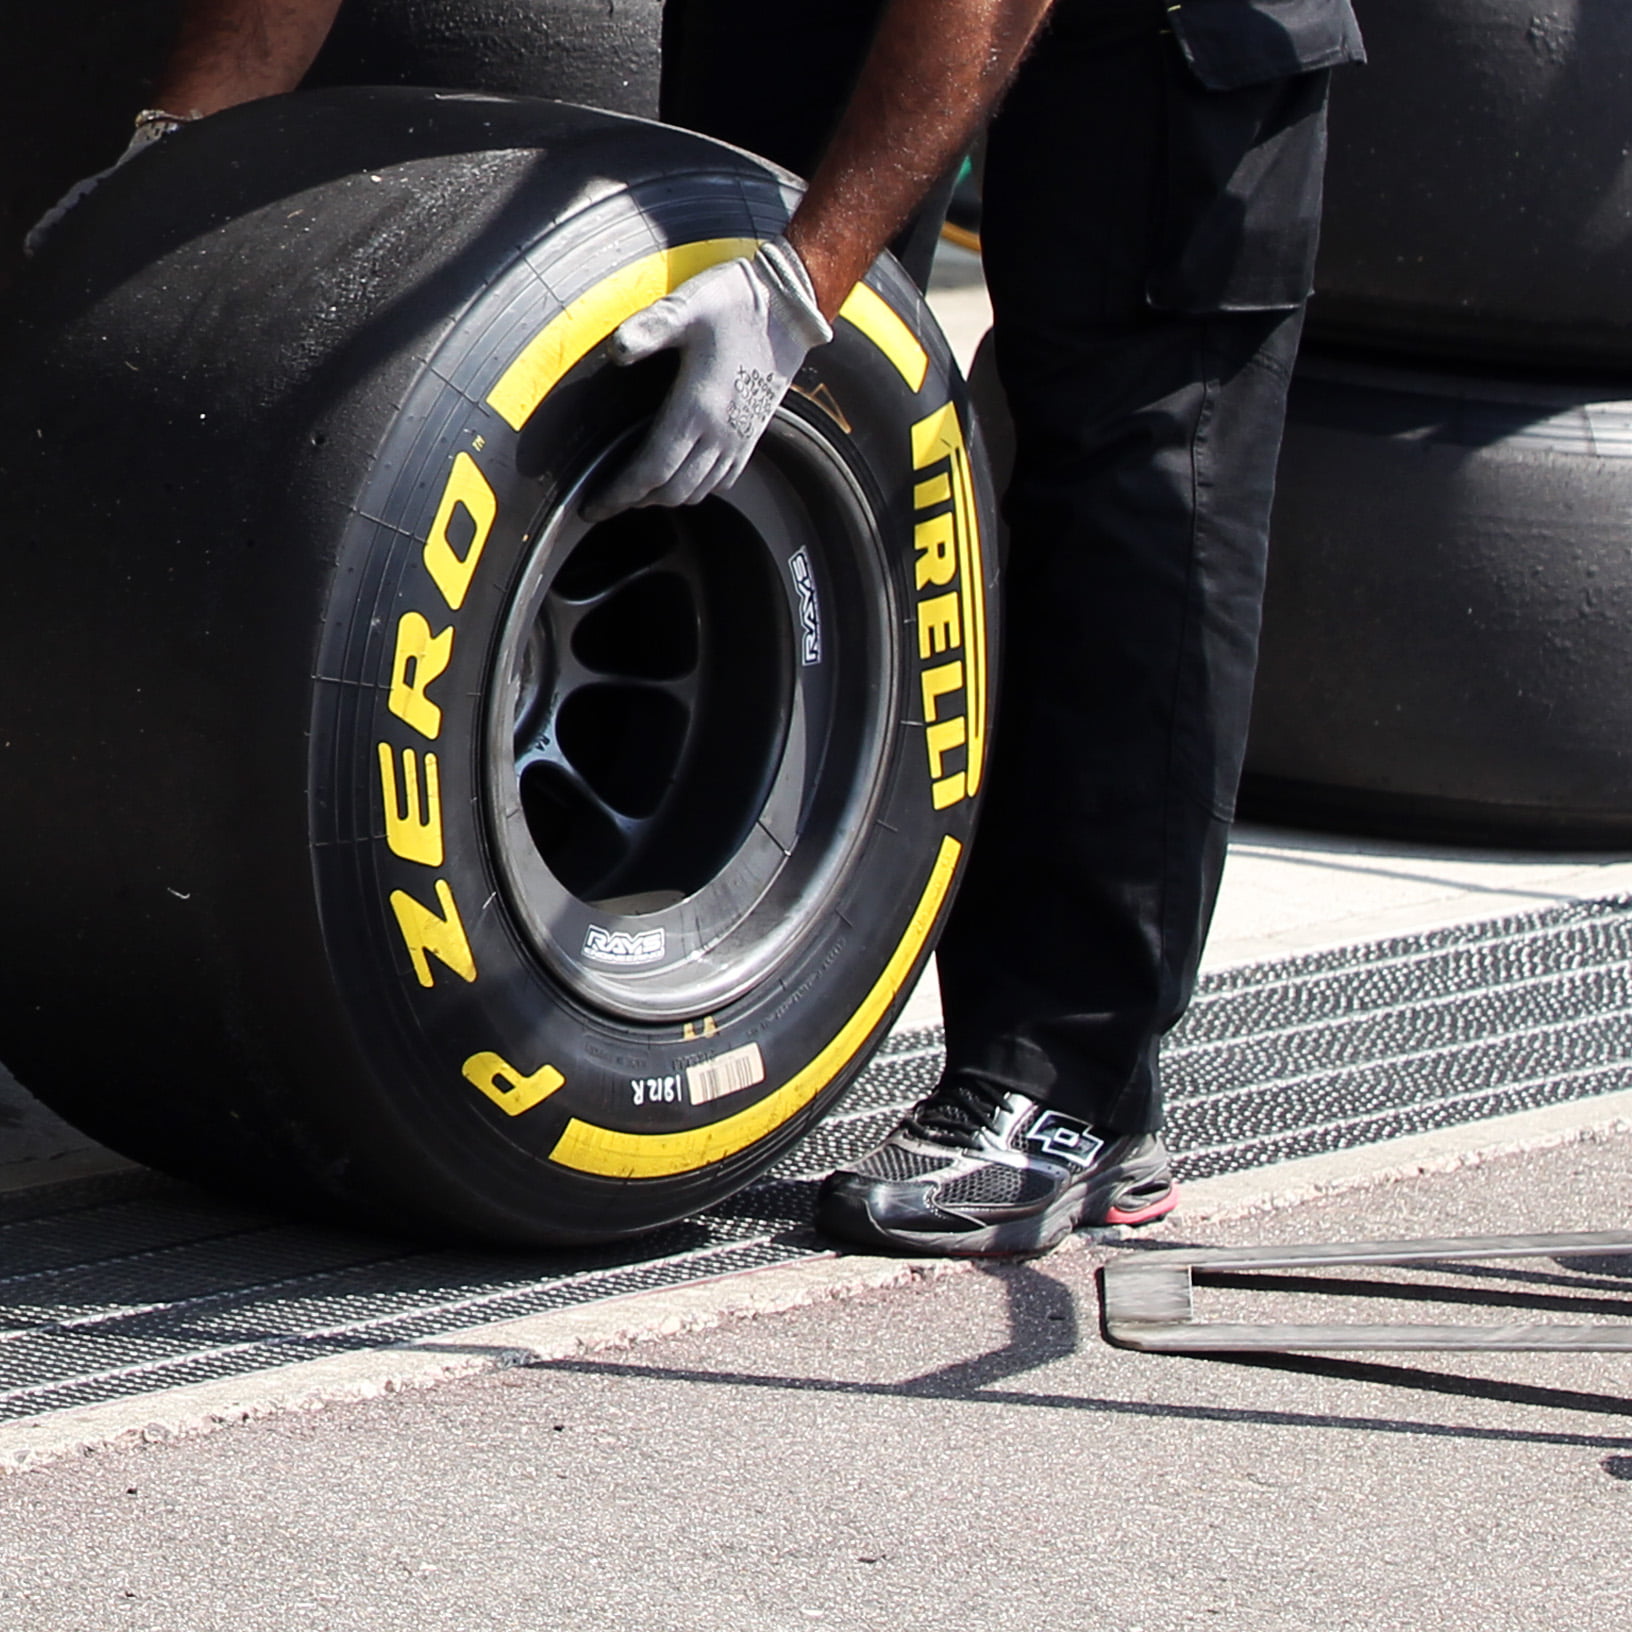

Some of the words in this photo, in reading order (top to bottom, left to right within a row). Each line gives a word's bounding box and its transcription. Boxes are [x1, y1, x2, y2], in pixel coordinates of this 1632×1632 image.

[790, 553, 818, 662] RAYS
[910, 400, 989, 810] PIRELLI
[377, 450, 498, 988] ZERO
[586, 930, 662, 955] RAYS
[461, 1050, 566, 1116] P
